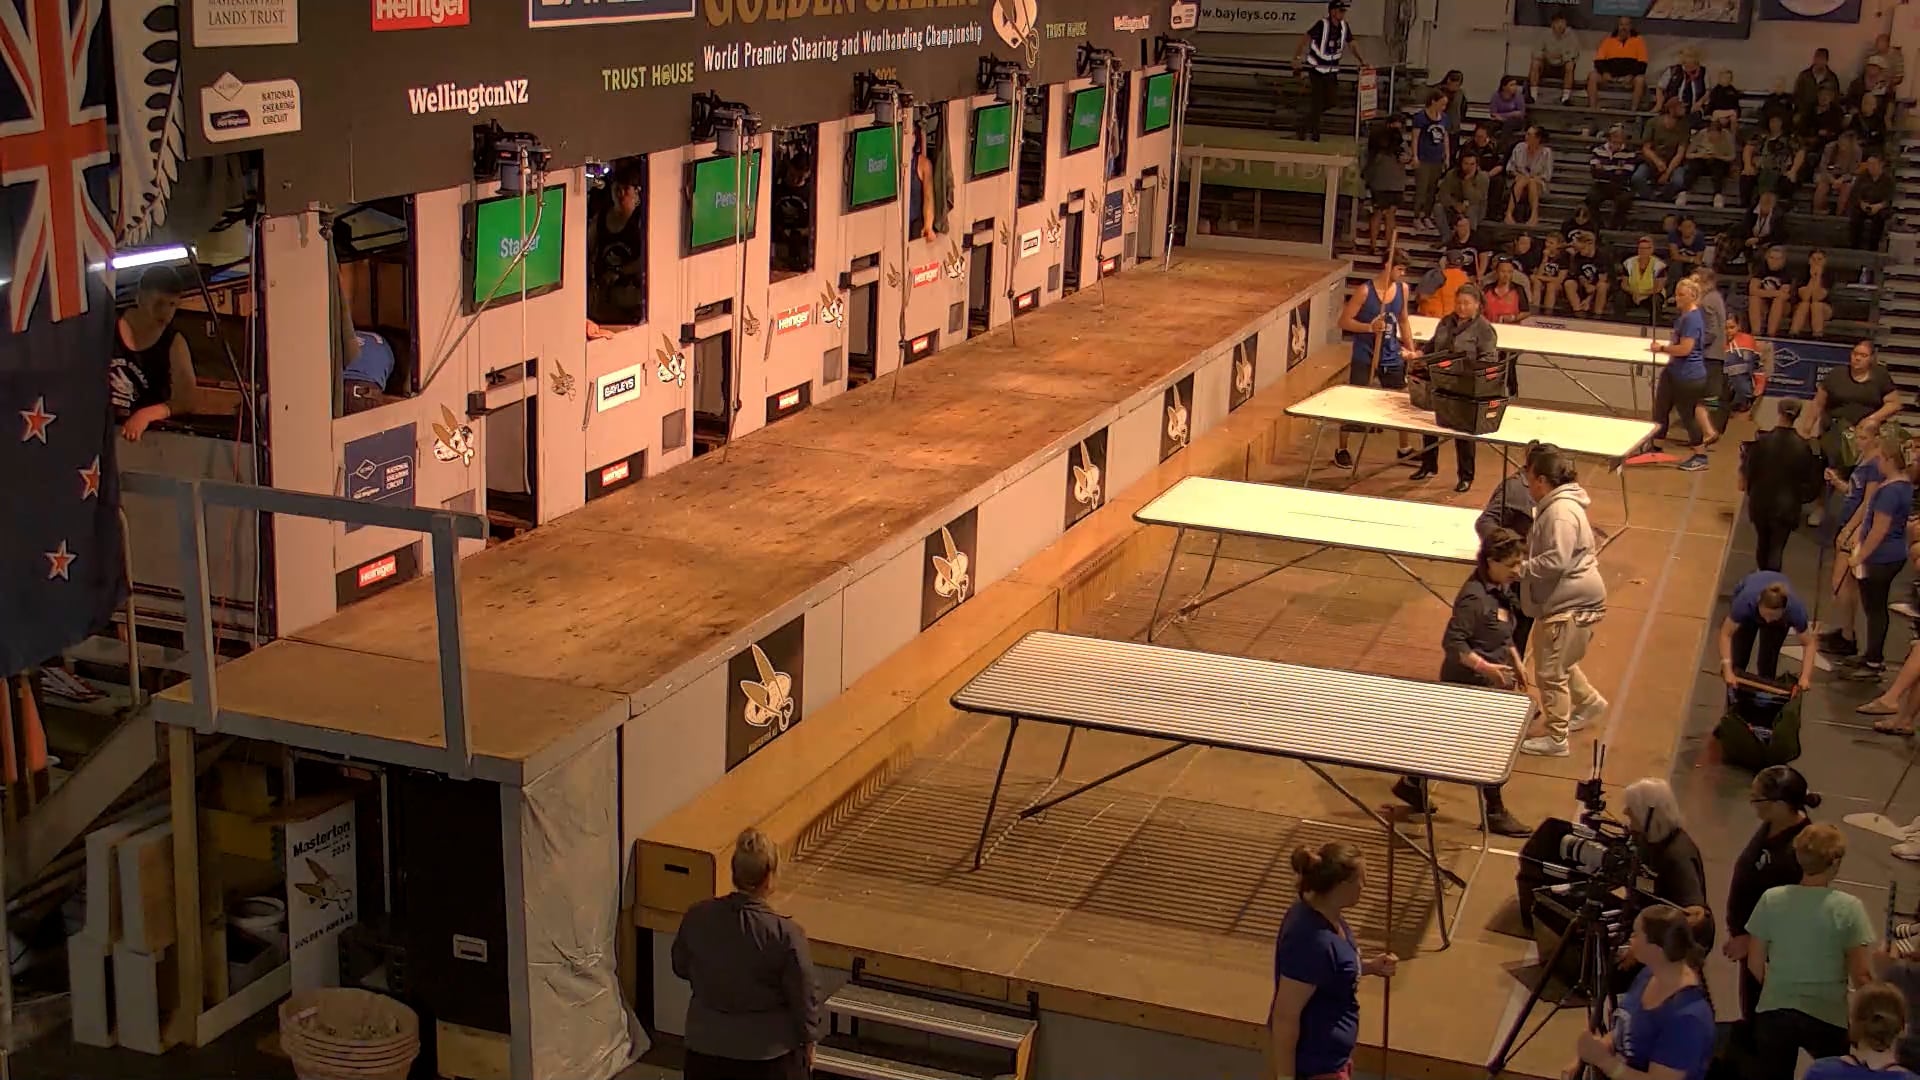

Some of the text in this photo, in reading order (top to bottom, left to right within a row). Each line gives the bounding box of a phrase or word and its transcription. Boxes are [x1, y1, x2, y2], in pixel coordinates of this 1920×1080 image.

[208, 9, 286, 25] LANDS TRUST
[1199, 8, 1297, 21] w.bayleys.co.nz
[703, 21, 982, 72] World Premier Shearing and Woolhandling Championship
[602, 62, 695, 91] TRUST HOUSE
[261, 88, 295, 101] NATIONAL
[408, 78, 529, 114] WellingtonNZ
[778, 311, 810, 330] Heiniger
[293, 821, 351, 858] Masterton
